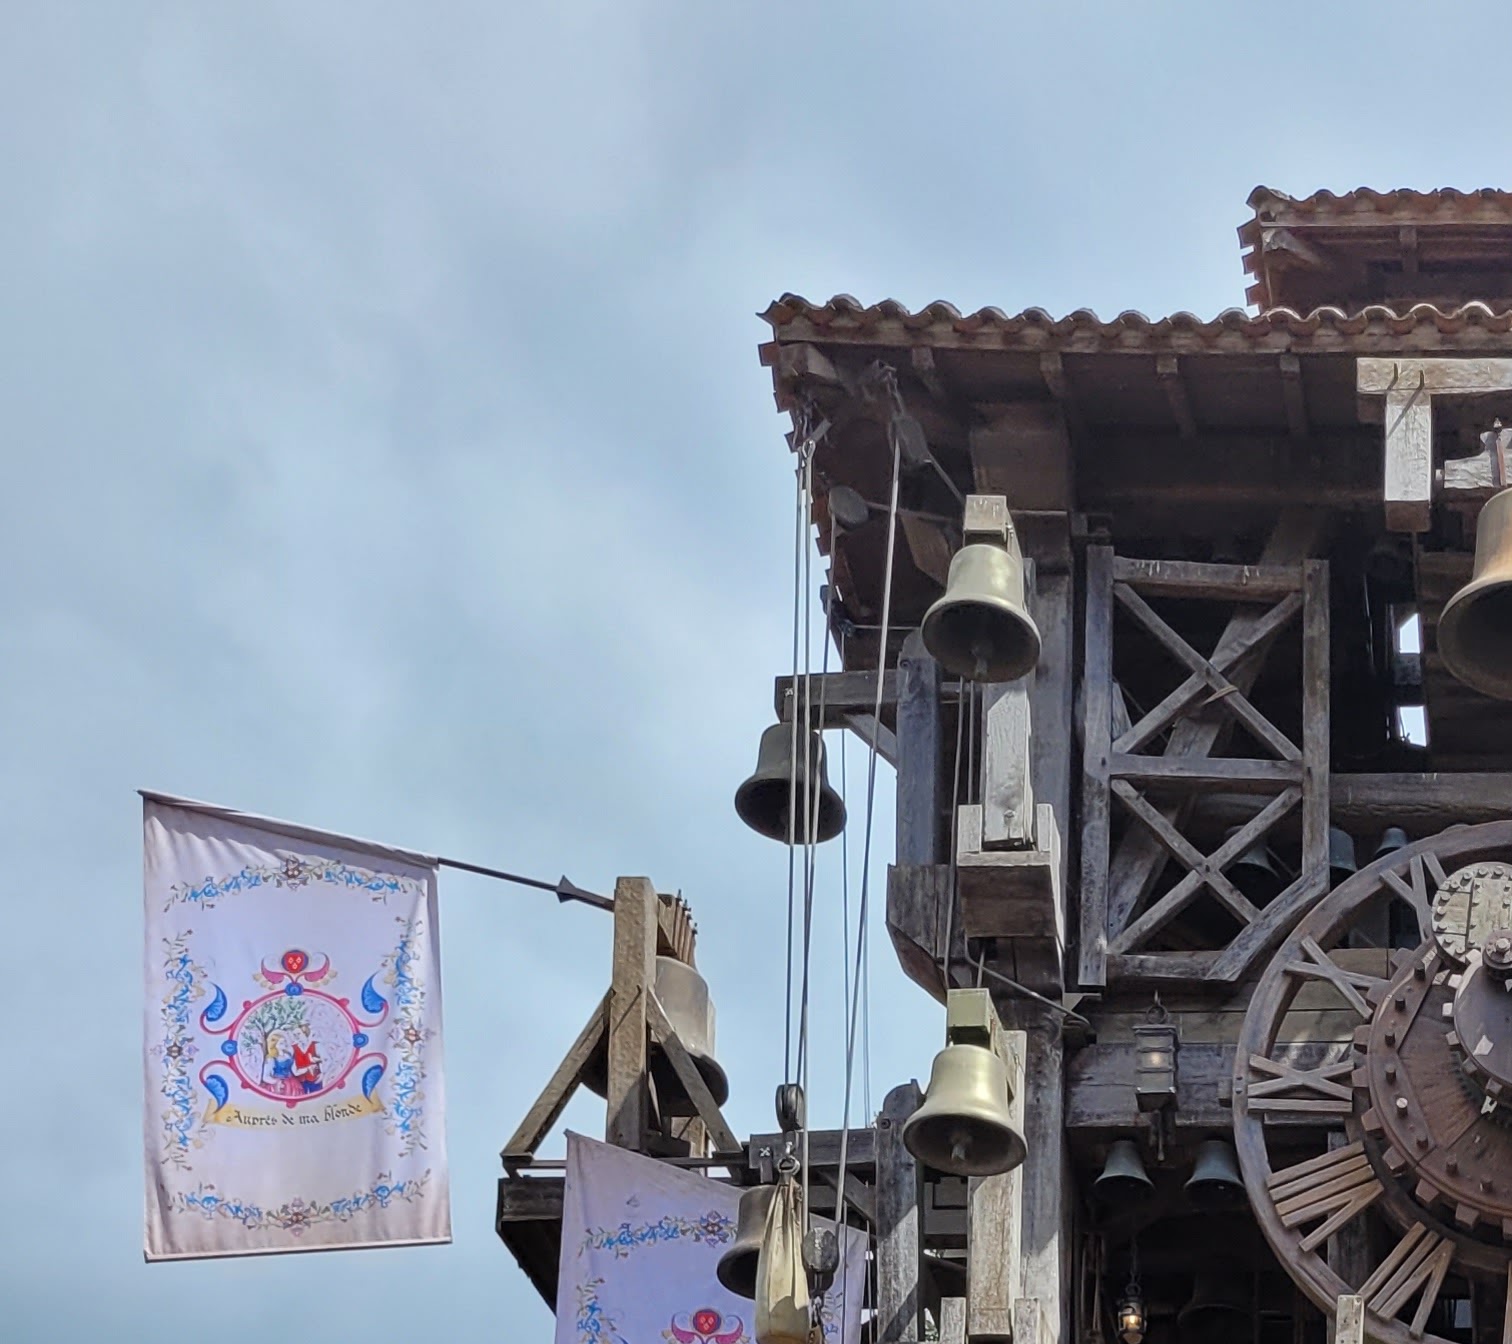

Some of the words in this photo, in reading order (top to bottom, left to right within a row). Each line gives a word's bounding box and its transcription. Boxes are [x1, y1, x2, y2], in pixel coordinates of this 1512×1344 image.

[281, 1113, 295, 1126] de
[299, 1114, 321, 1125] ma
[324, 1104, 362, 1122] blonde
